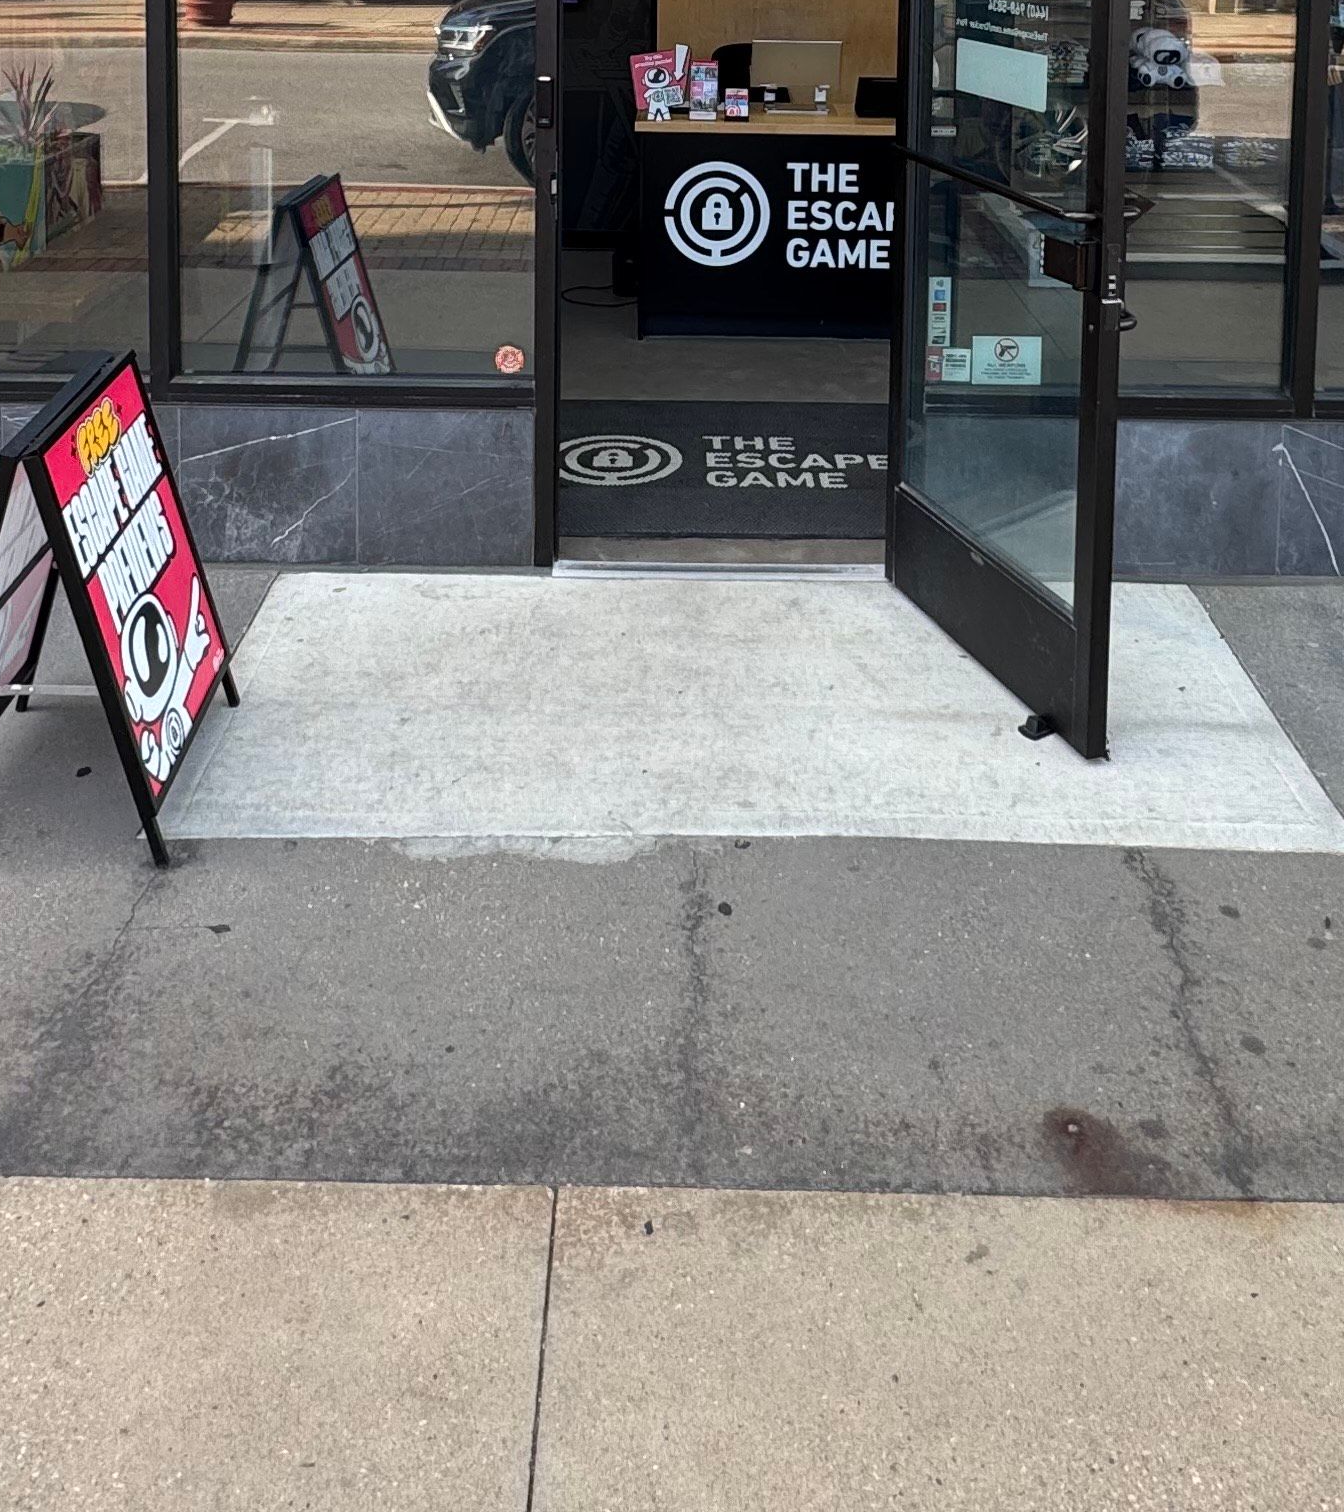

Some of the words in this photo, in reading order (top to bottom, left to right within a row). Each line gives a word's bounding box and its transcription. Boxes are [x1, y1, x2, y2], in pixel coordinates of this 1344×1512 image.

[786, 163, 859, 193] THE
[786, 239, 891, 270] GAME
[76, 396, 122, 477] FREE
[702, 435, 796, 451] THE
[705, 451, 888, 471] ESCAPE
[706, 471, 849, 489] GAME
[62, 456, 131, 580] ESCAPE
[113, 412, 163, 511] GAME
[96, 490, 174, 636] PREVIEWS
